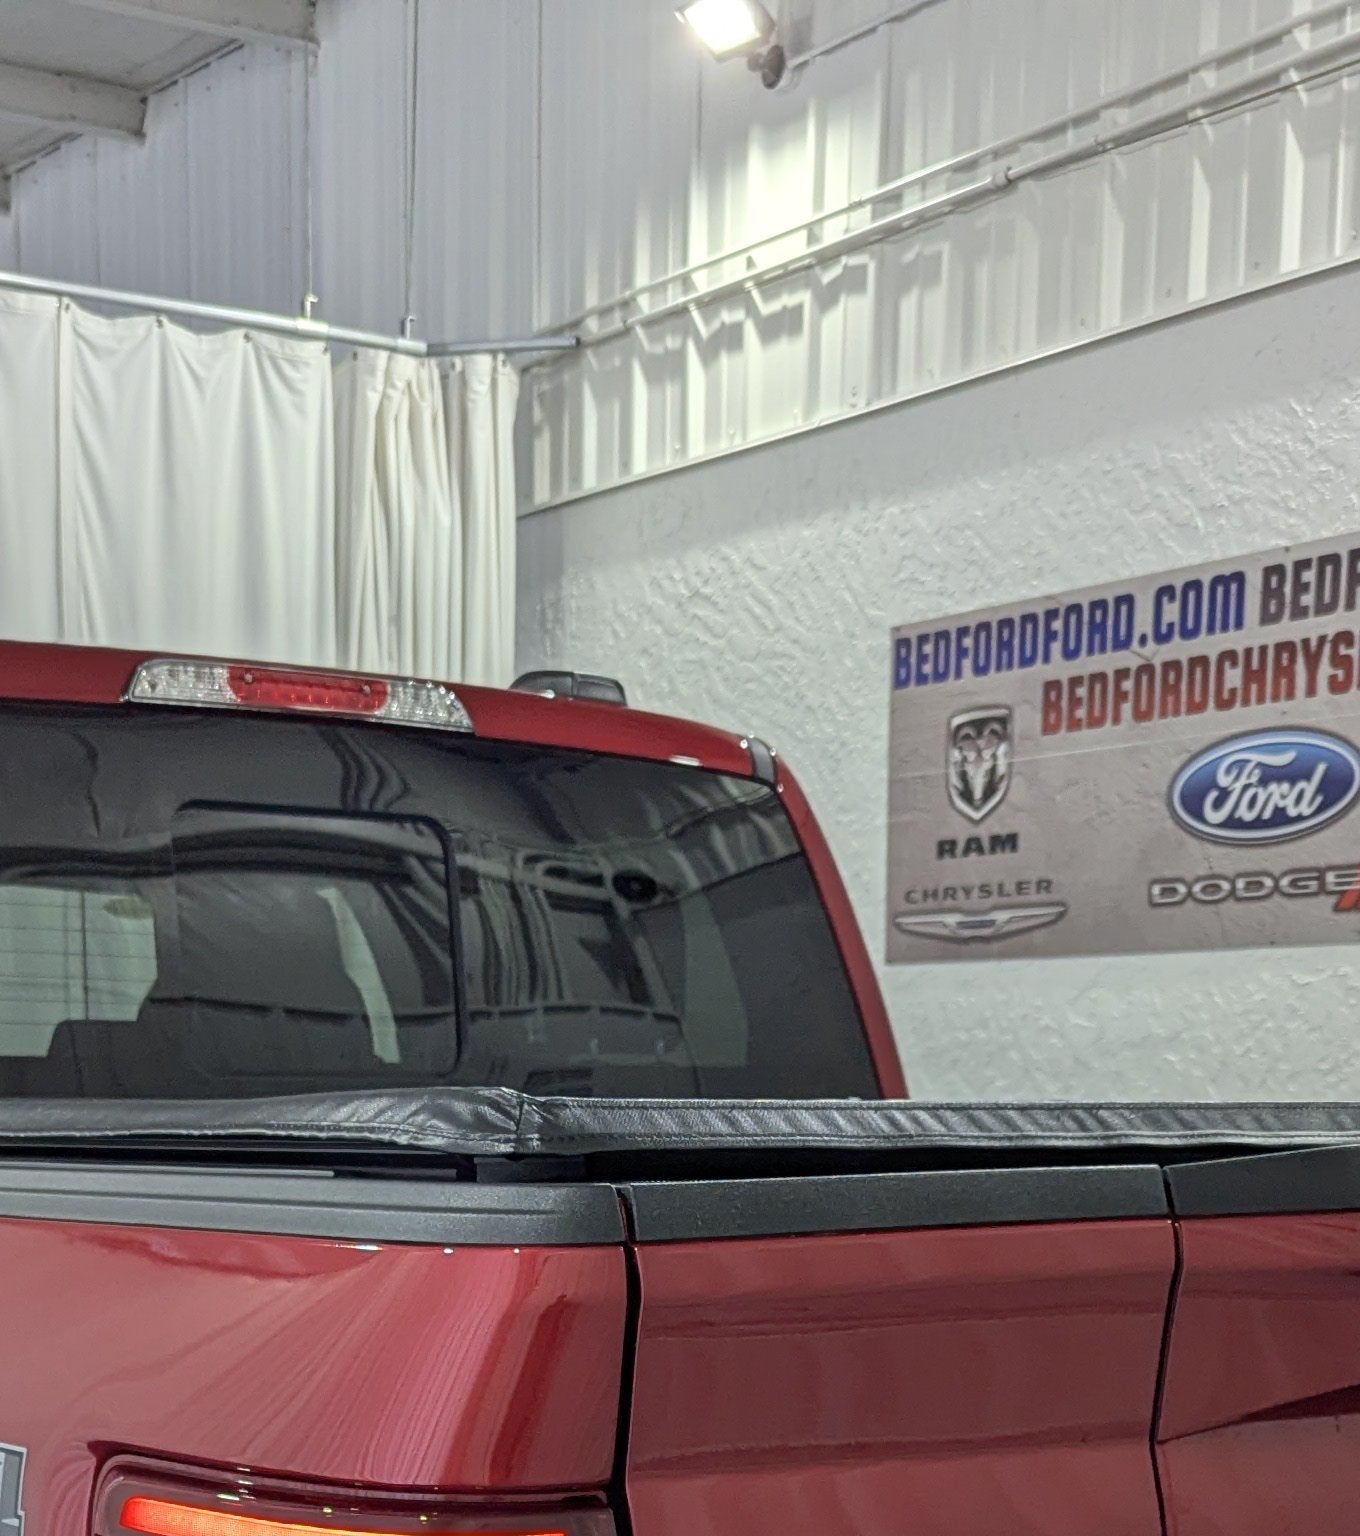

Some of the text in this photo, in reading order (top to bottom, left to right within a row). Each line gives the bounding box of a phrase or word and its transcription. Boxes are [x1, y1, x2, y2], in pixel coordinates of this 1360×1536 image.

[893, 569, 1245, 691] BEDFORDFORD.COM
[1203, 750, 1329, 825] Ford
[936, 832, 1020, 861] RAM
[904, 878, 1054, 905] CHRYSLER
